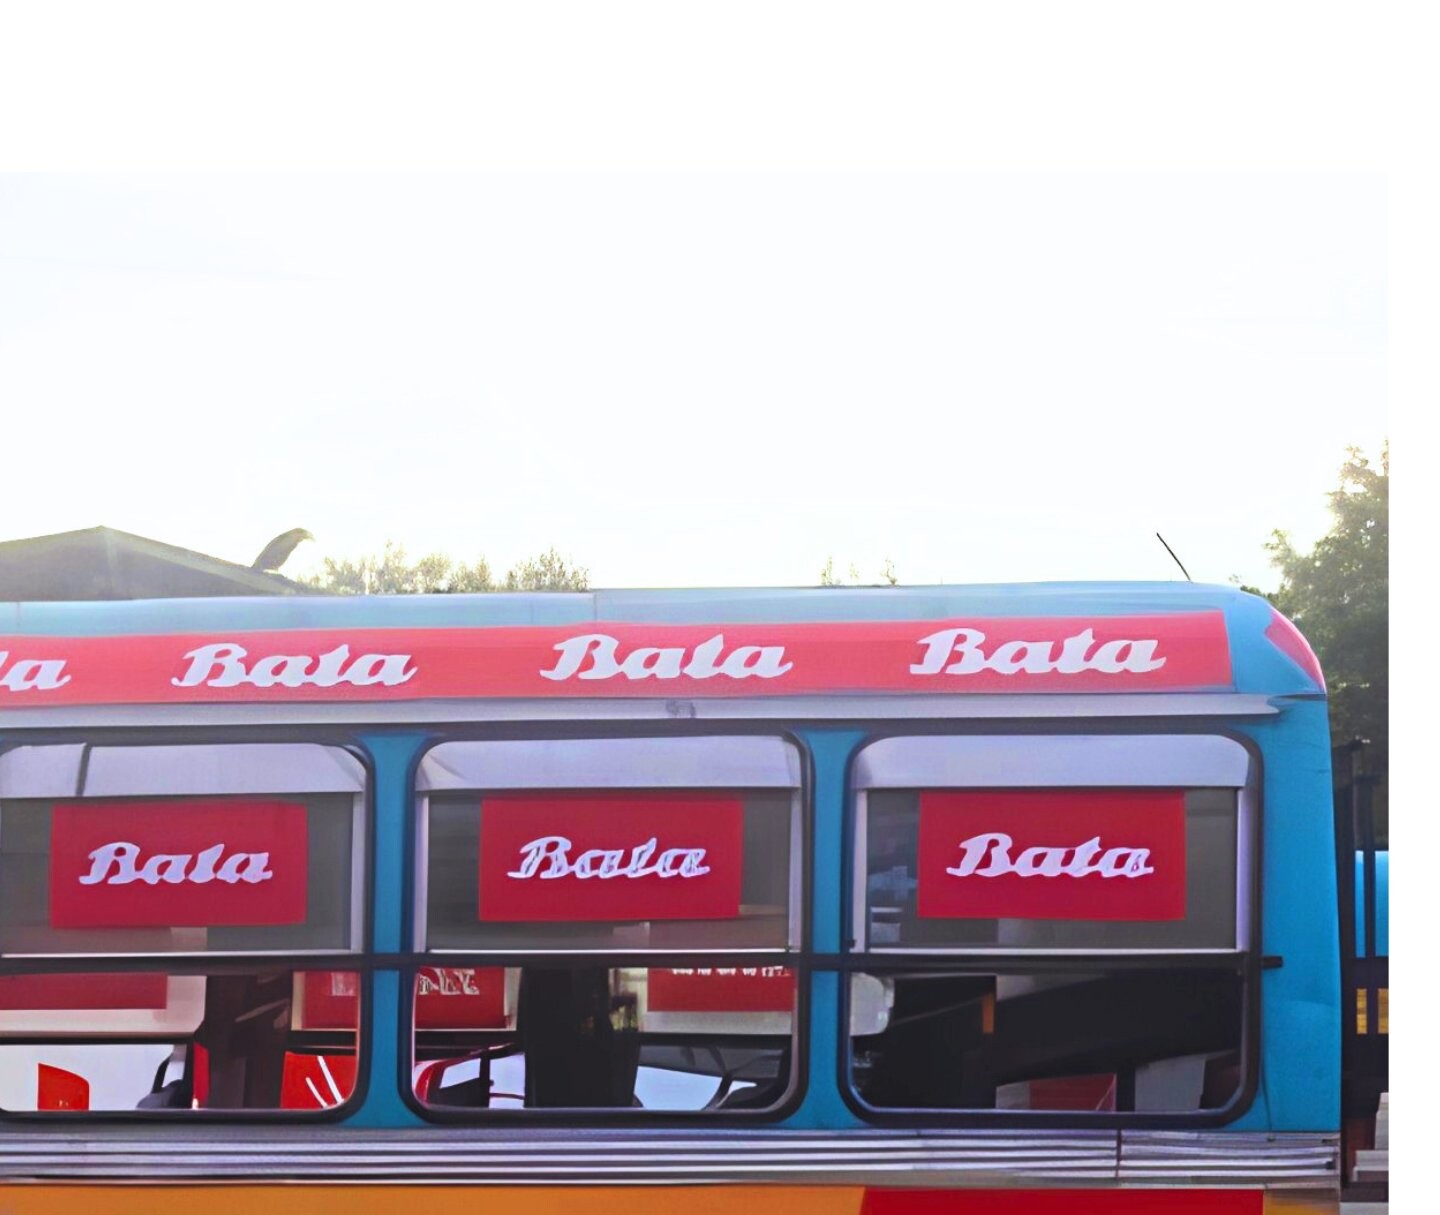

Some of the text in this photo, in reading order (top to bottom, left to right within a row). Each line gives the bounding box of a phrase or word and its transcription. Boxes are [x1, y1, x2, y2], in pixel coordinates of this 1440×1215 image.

[171, 643, 417, 687] Bata
[537, 636, 793, 680] Bata
[910, 628, 1166, 674] Bata
[79, 842, 272, 884] Bata
[507, 836, 710, 879] Bata
[946, 833, 1154, 878] Bata
